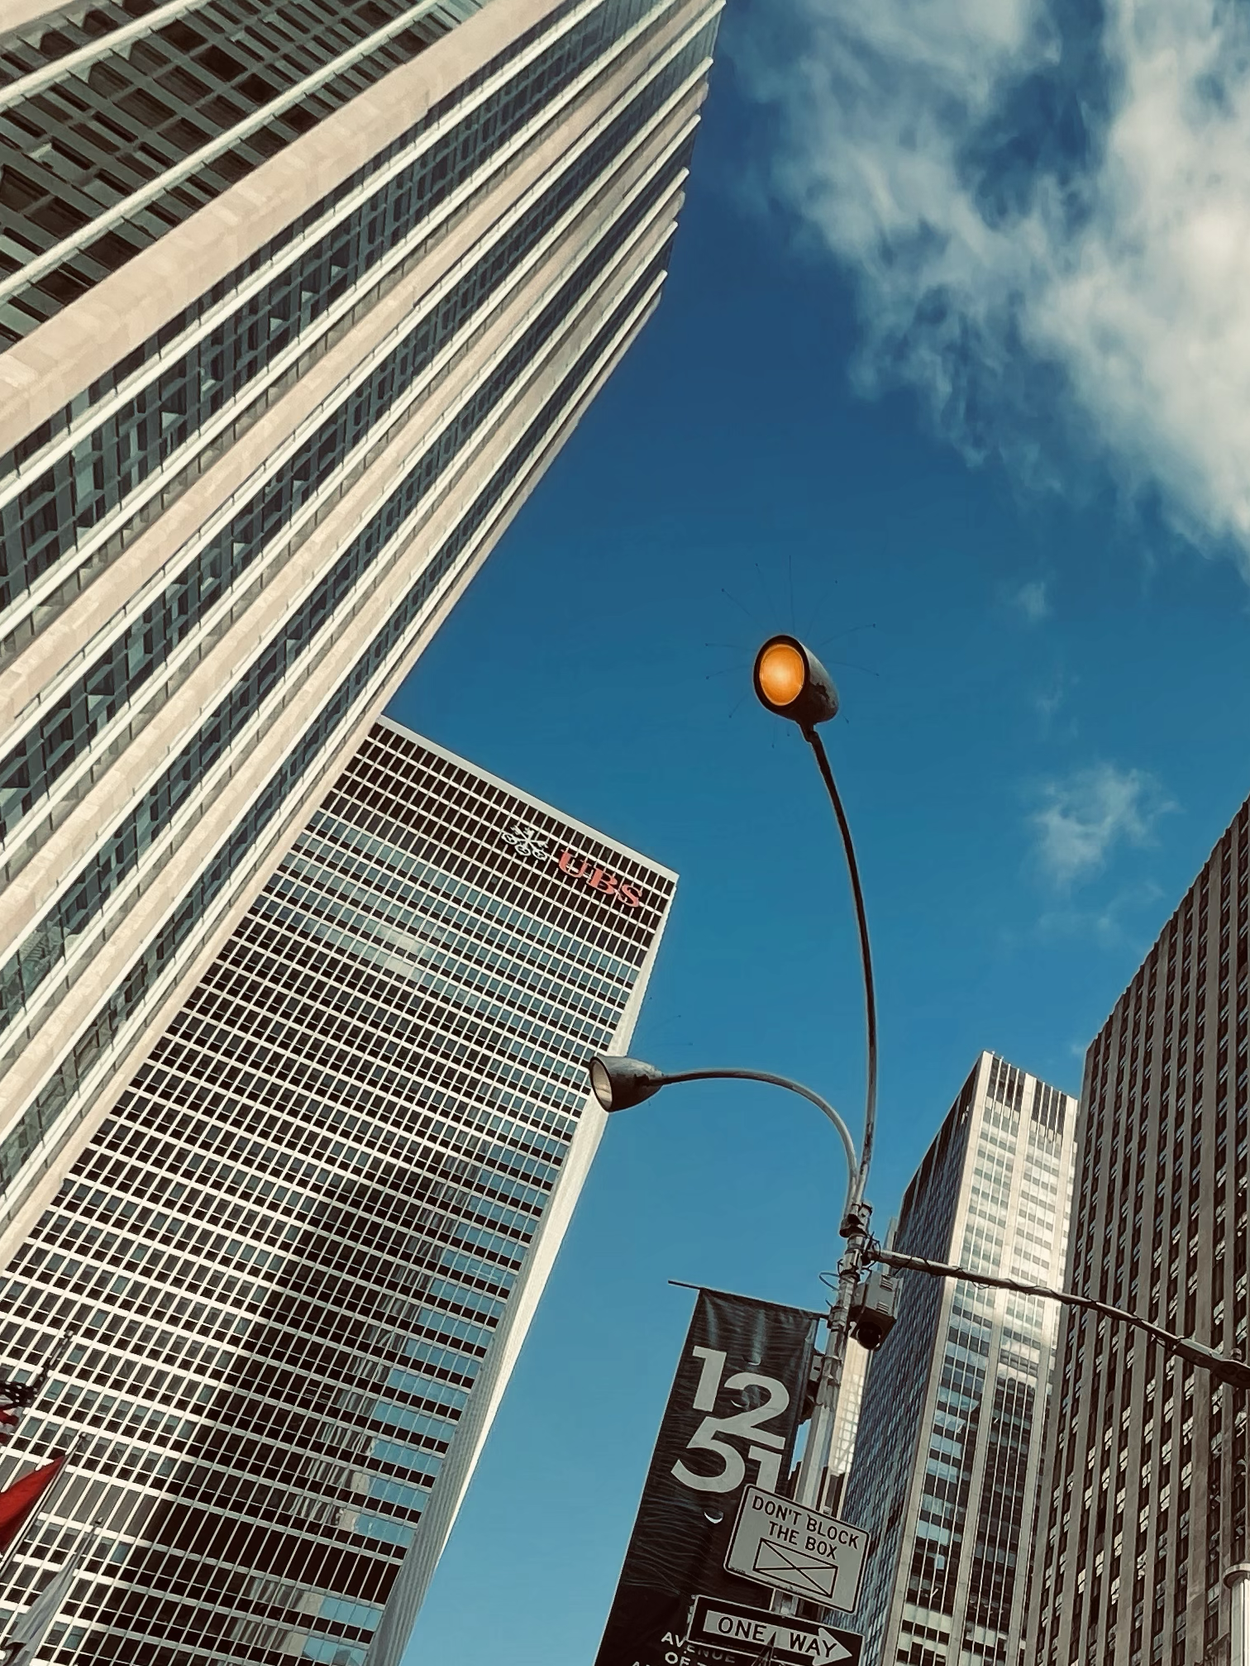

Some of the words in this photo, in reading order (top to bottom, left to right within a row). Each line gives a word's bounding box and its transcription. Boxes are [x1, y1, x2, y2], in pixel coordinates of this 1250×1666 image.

[558, 850, 644, 908] UBS
[692, 1345, 790, 1450] 12
[670, 1416, 783, 1494] 51
[751, 1495, 802, 1526] DON'T
[806, 1515, 860, 1550] BLOCK
[768, 1521, 800, 1546] THE
[804, 1536, 838, 1561] BOX
[717, 1616, 768, 1643] ONE
[788, 1632, 838, 1659] WAY
